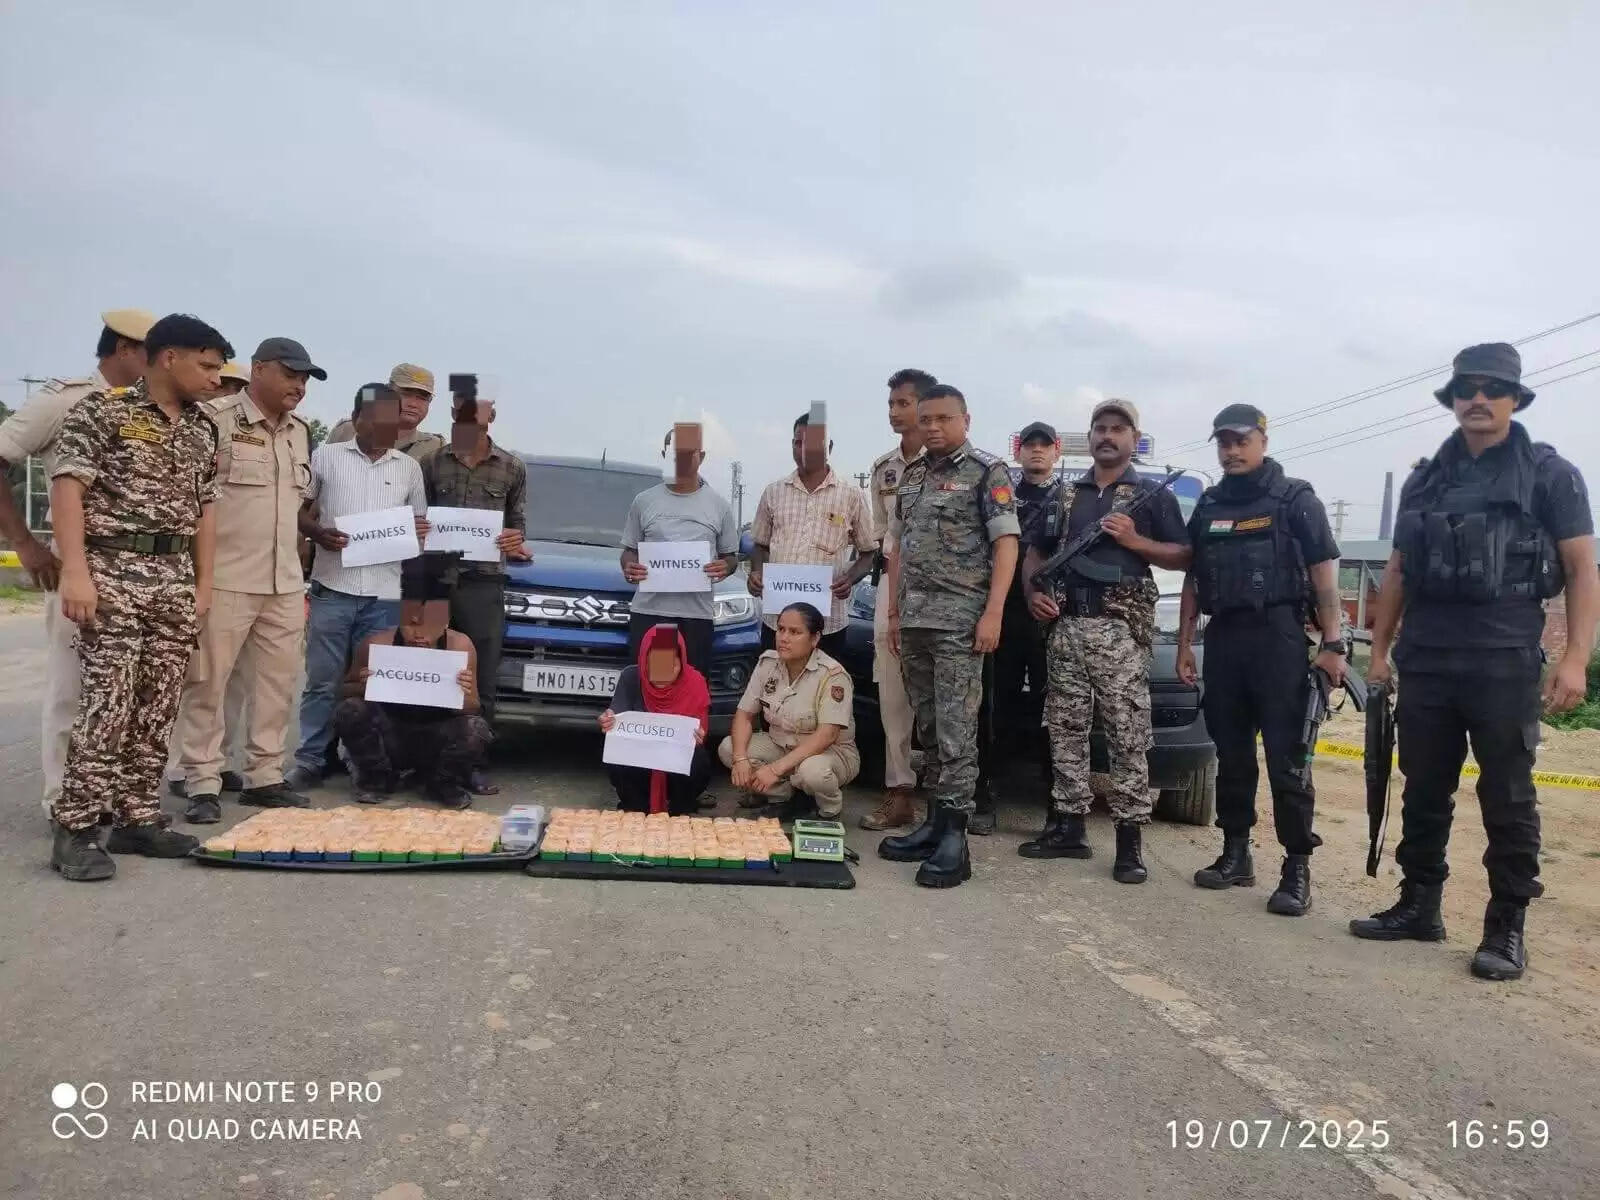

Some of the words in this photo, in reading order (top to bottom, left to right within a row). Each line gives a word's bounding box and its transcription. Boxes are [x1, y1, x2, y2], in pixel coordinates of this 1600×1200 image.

[352, 525, 405, 542] WITNESS
[649, 559, 700, 570] WITNESS
[773, 581, 822, 593] WITNESS
[375, 669, 440, 684] ACCUSED
[537, 672, 616, 692] MN01AS15
[617, 722, 675, 738] ACCUSED
